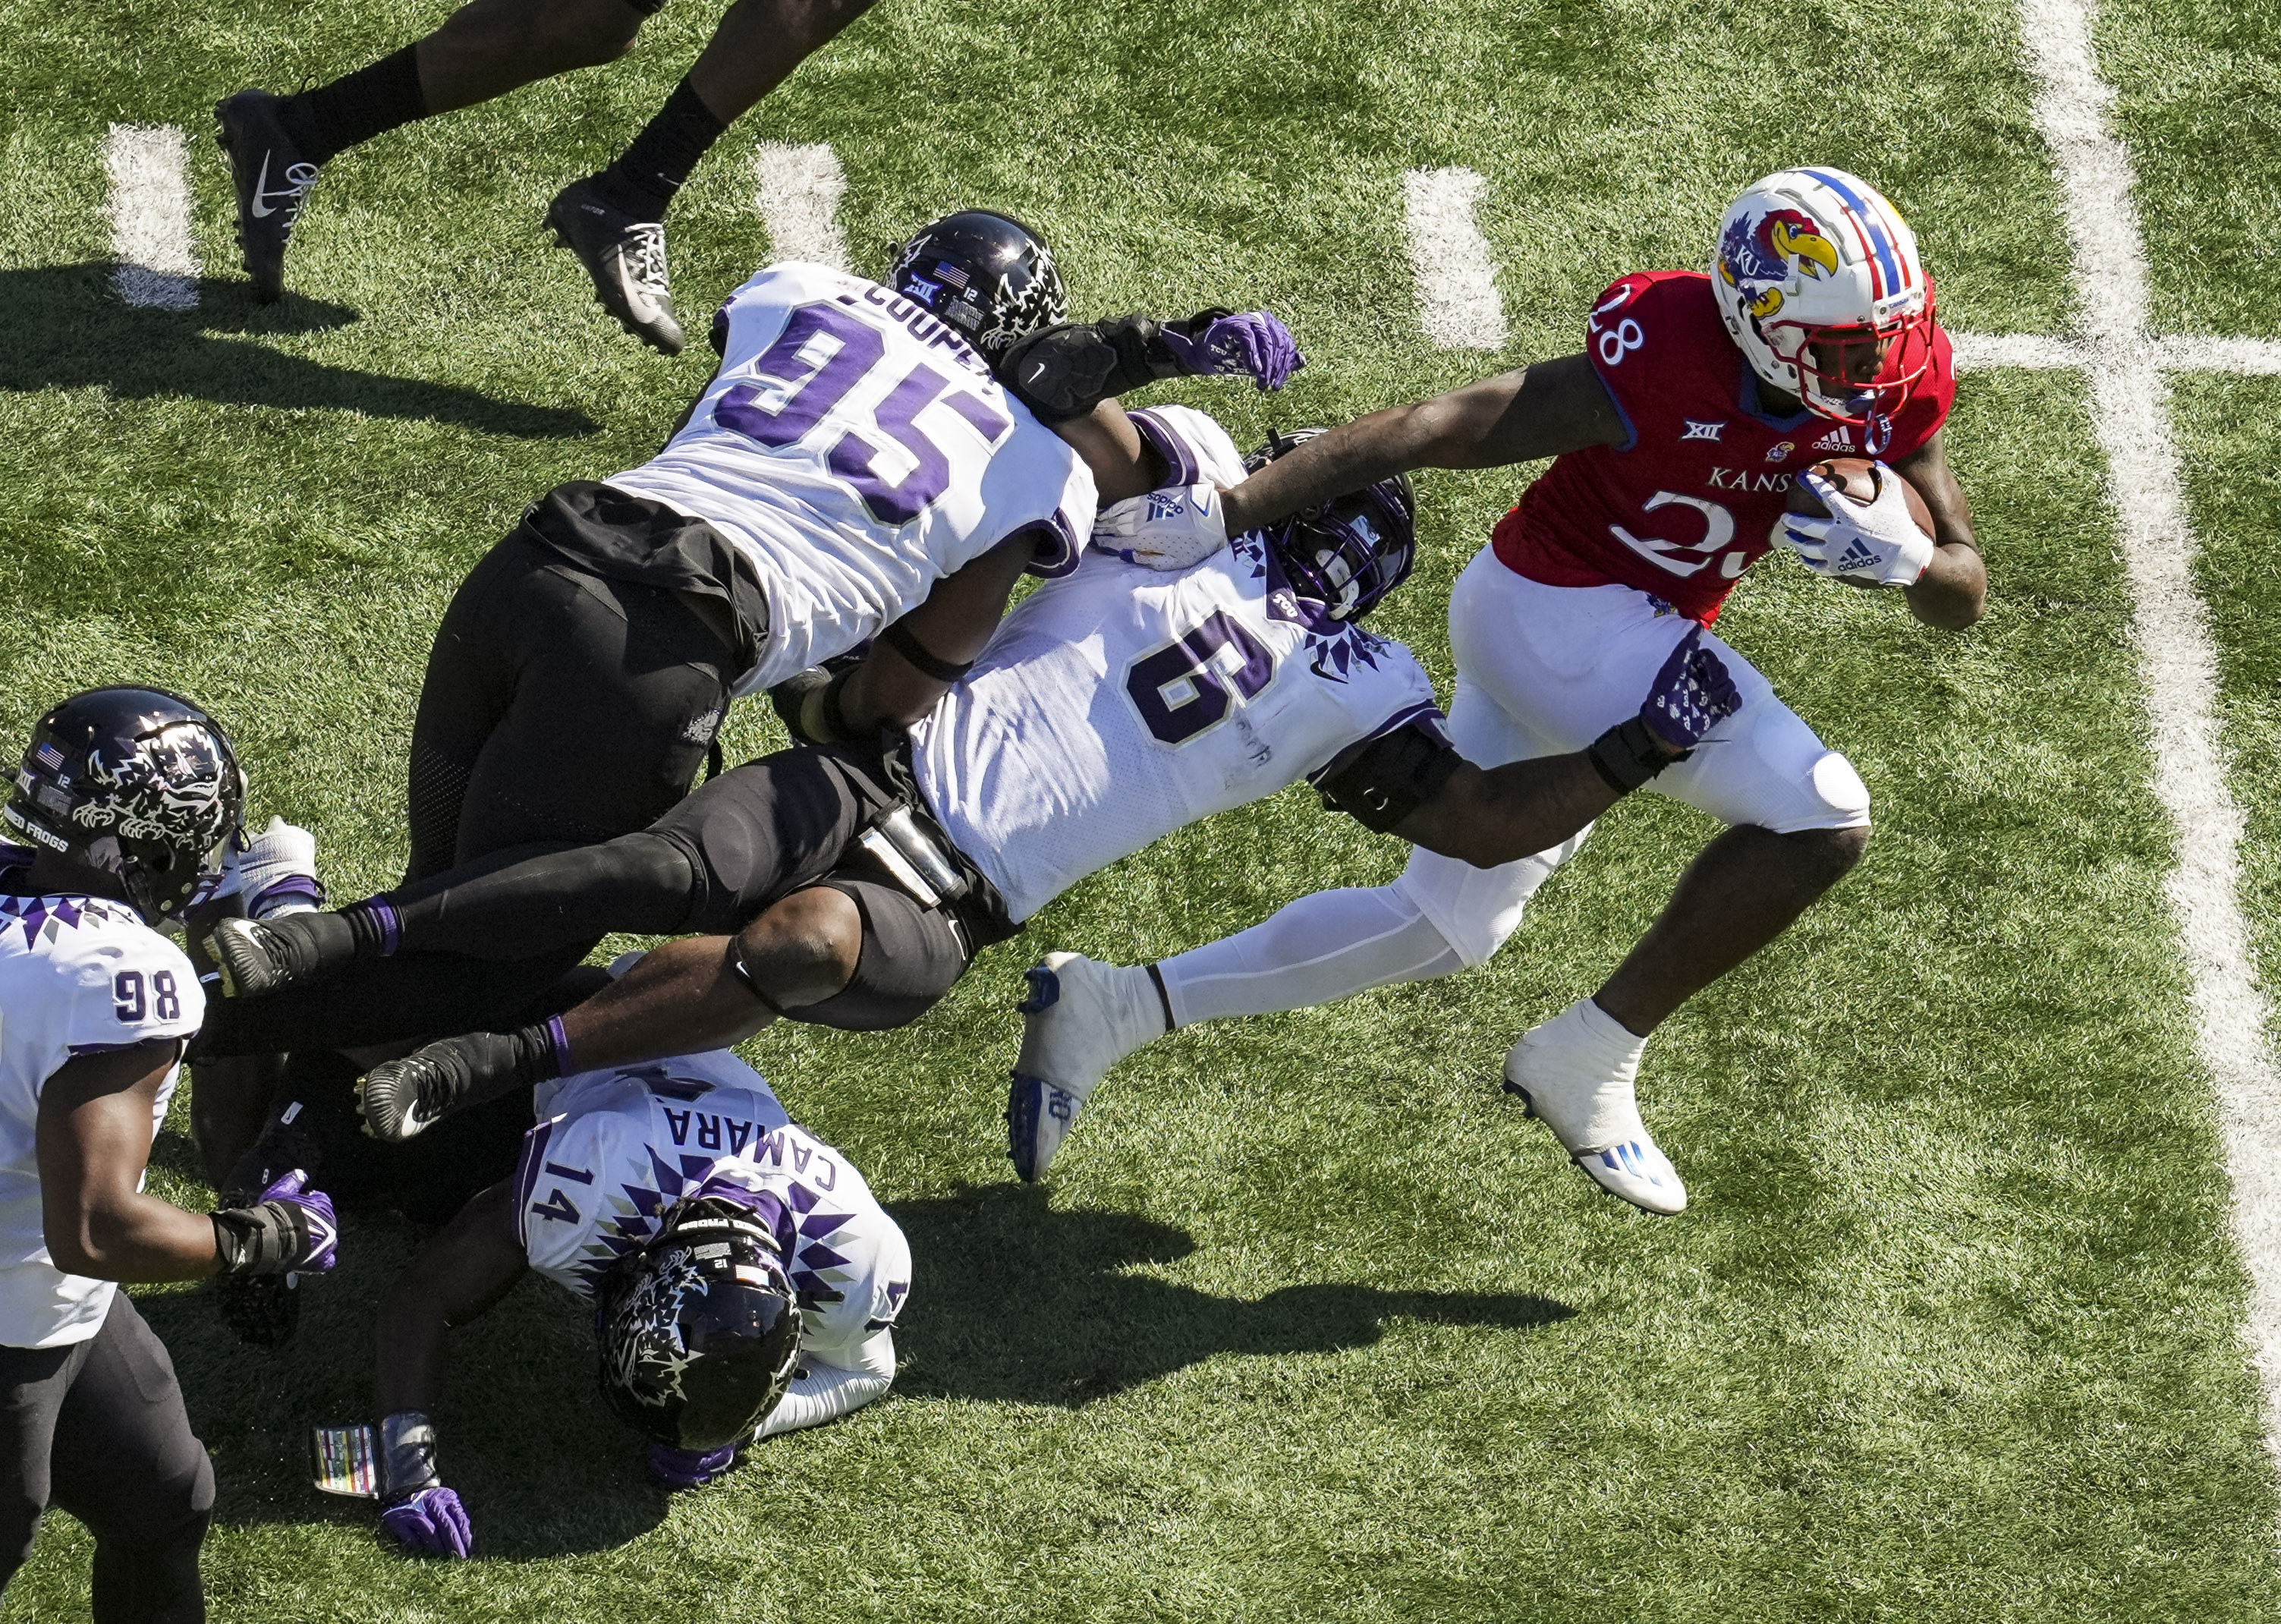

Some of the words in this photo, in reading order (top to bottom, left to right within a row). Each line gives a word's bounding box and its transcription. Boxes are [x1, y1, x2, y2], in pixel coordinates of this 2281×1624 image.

[1735, 244, 1760, 276] KU
[963, 287, 978, 302] 12
[1589, 283, 1644, 365] 28
[713, 300, 1015, 528] 95
[1681, 420, 1725, 442] XII
[1811, 440, 1856, 453] adidas
[1707, 466, 1793, 493] KANS
[1147, 491, 1184, 515] adidas
[1838, 555, 1882, 571] adidas
[1273, 593, 1298, 618] TCU
[1121, 605, 1278, 751] 6
[57, 773, 71, 788] 12
[26, 821, 69, 853] FROGS
[112, 969, 181, 1025] 98
[662, 1106, 836, 1191] CAMARA
[530, 1160, 596, 1226] 14
[713, 1258, 728, 1269] 12
